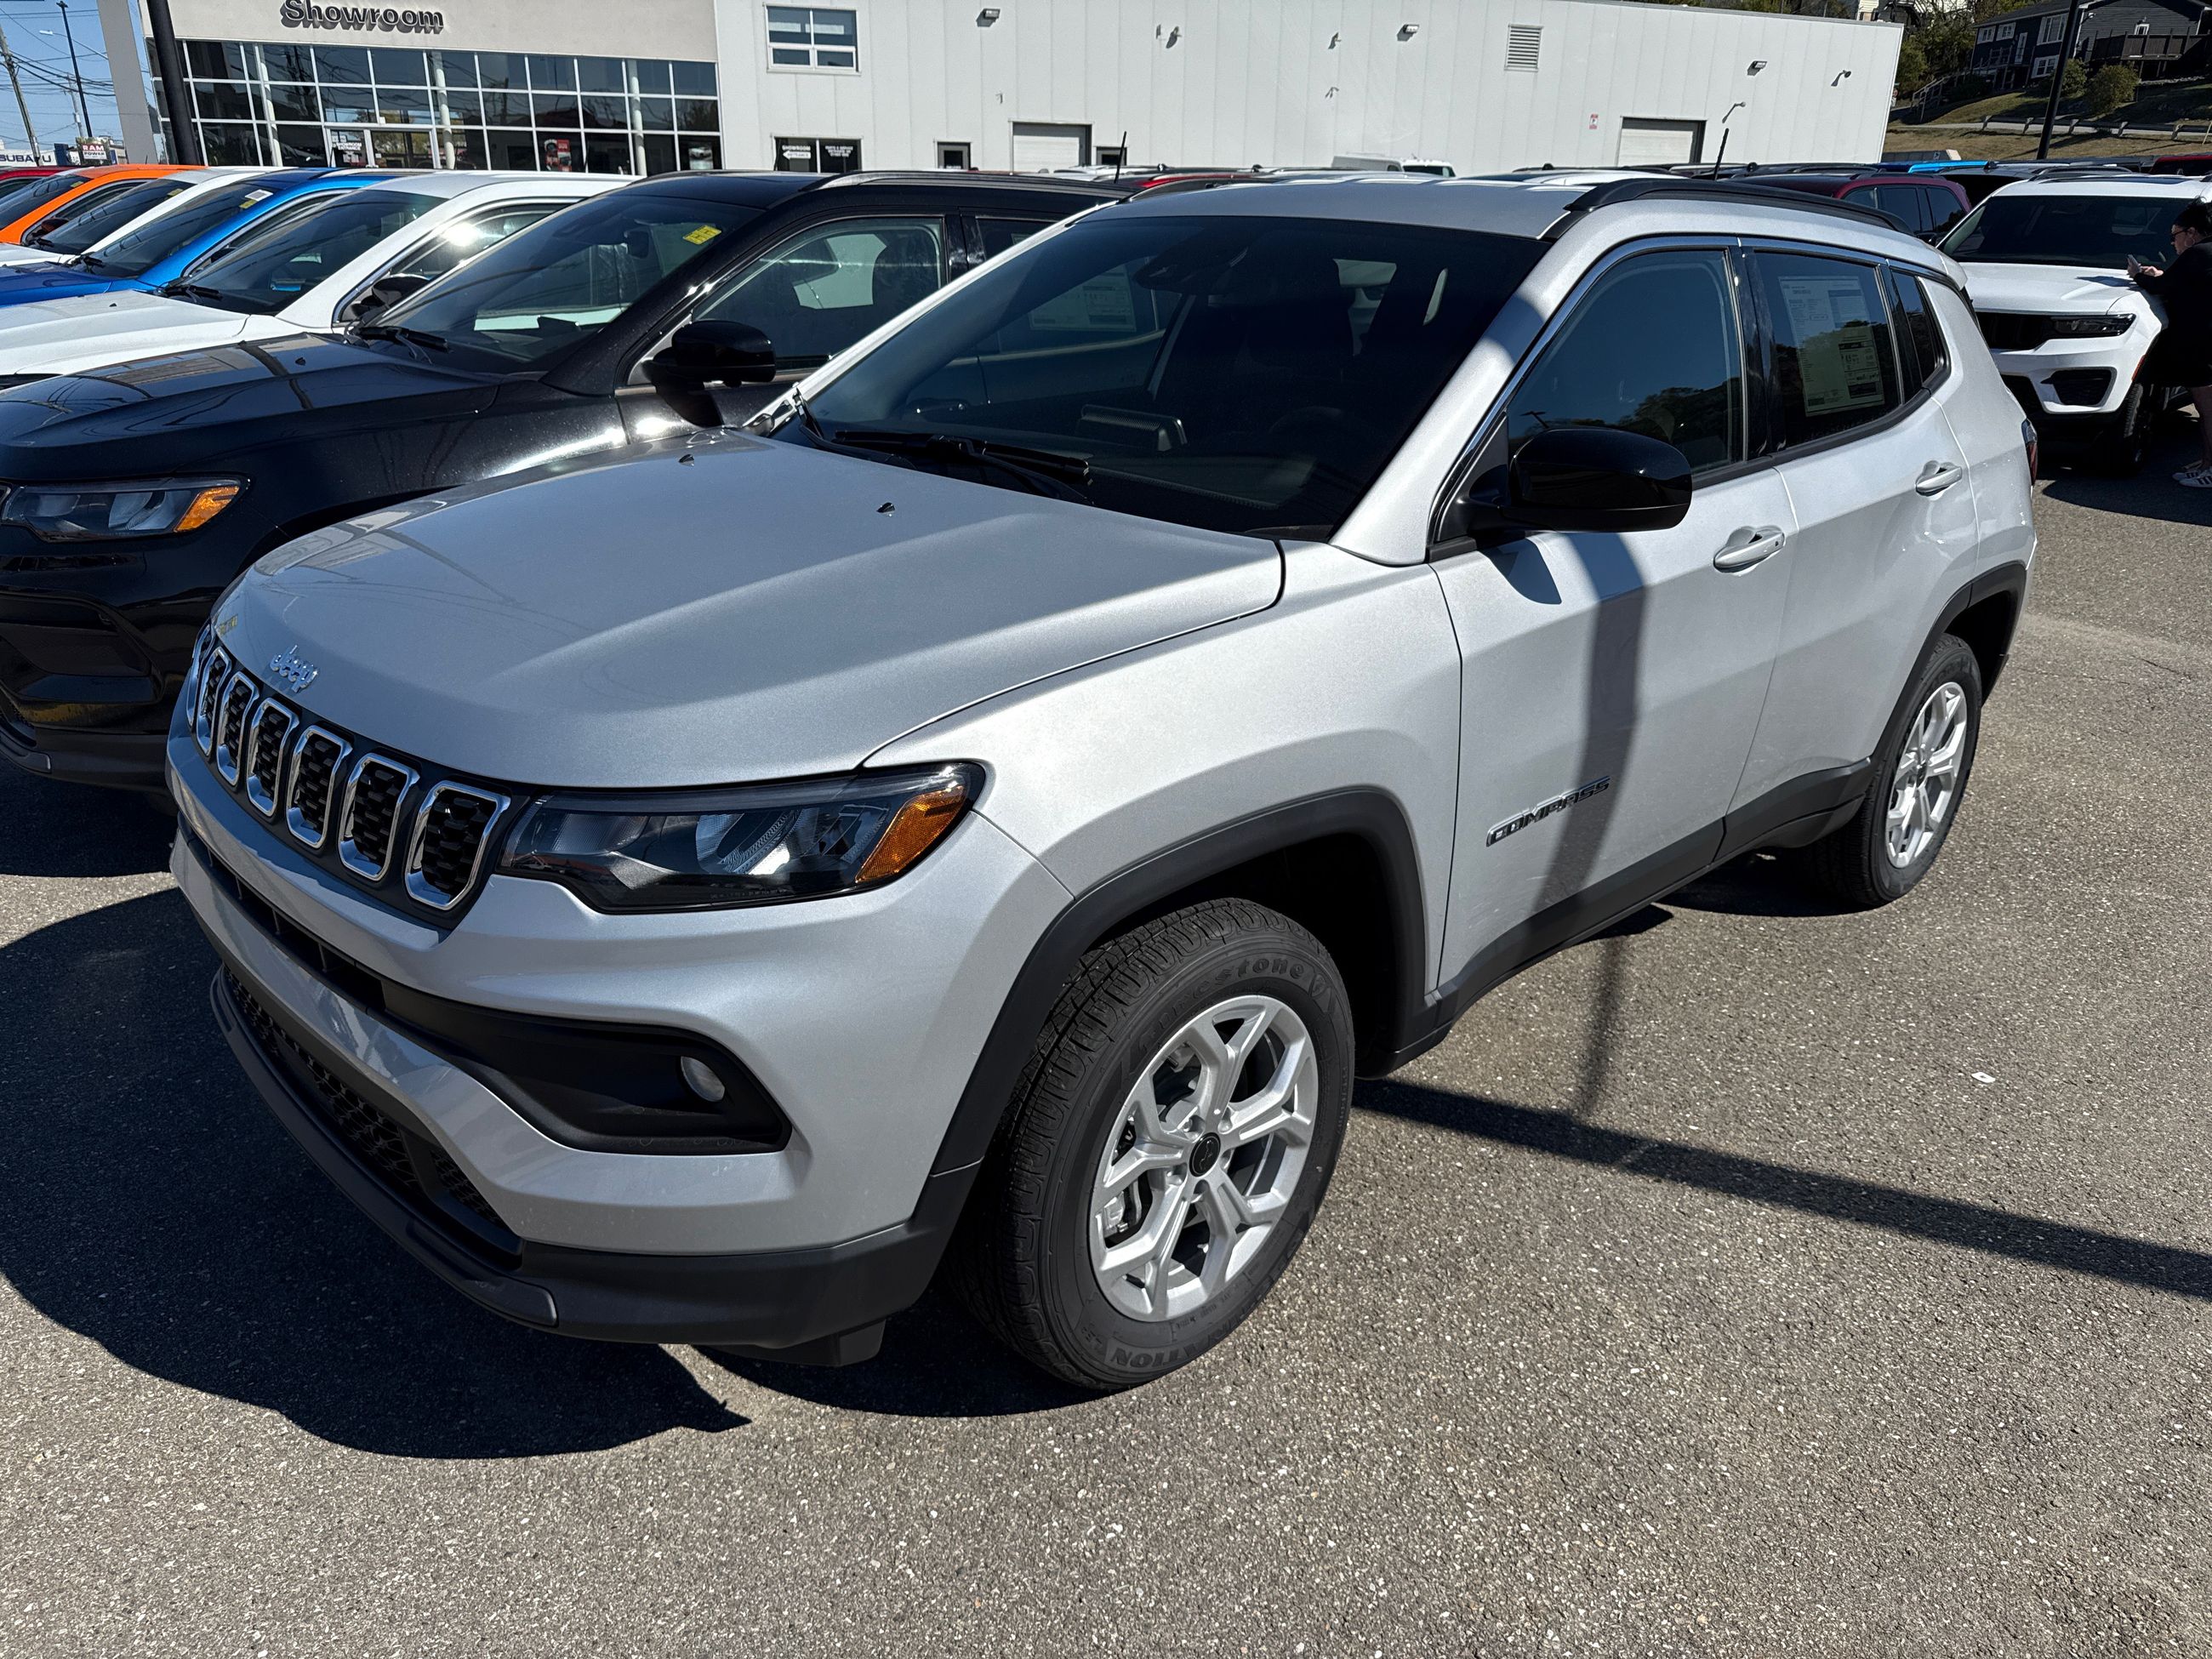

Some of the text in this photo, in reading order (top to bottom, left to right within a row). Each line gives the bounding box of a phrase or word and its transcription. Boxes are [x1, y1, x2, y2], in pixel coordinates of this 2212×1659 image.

[280, 0, 444, 34] Showroom
[0, 154, 52, 162] SUBAU
[270, 644, 318, 693] Jeep
[1485, 775, 1611, 847] COMPASS
